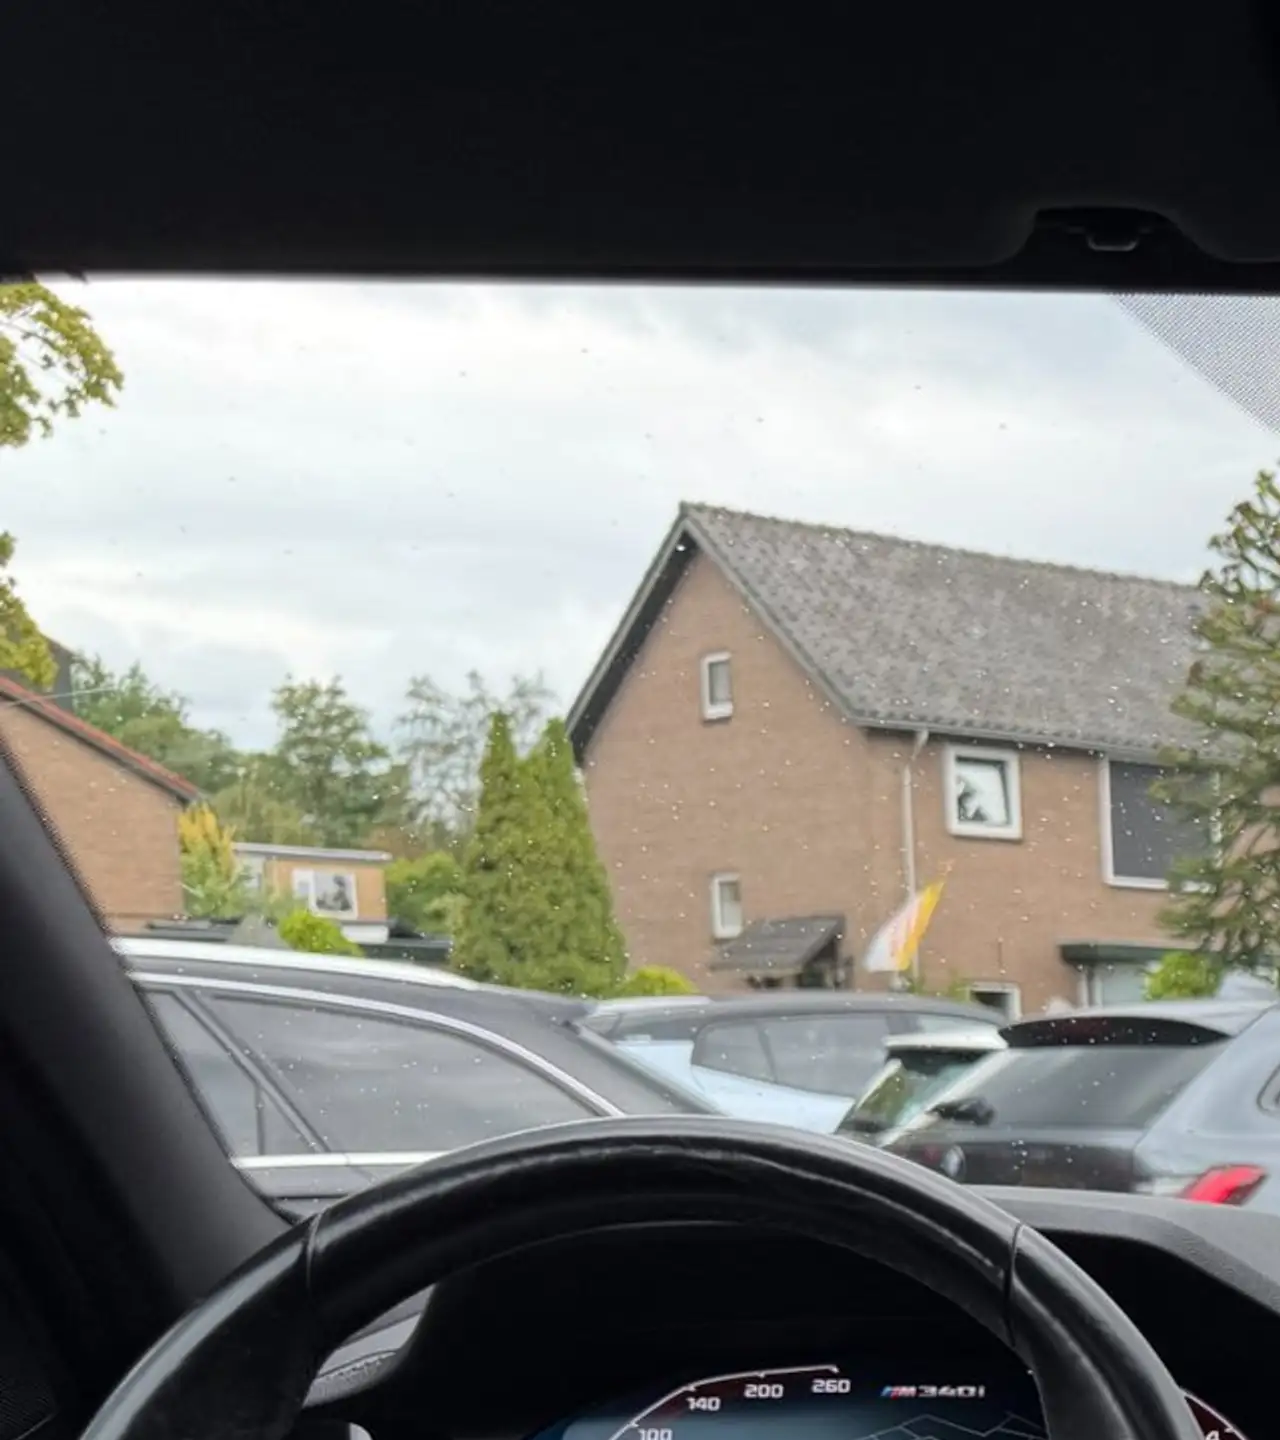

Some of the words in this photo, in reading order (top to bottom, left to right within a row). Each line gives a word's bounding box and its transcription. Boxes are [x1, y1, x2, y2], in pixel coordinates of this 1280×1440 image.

[744, 1383, 784, 1398] 200
[811, 1378, 851, 1394] 260
[687, 1396, 720, 1412] 140
